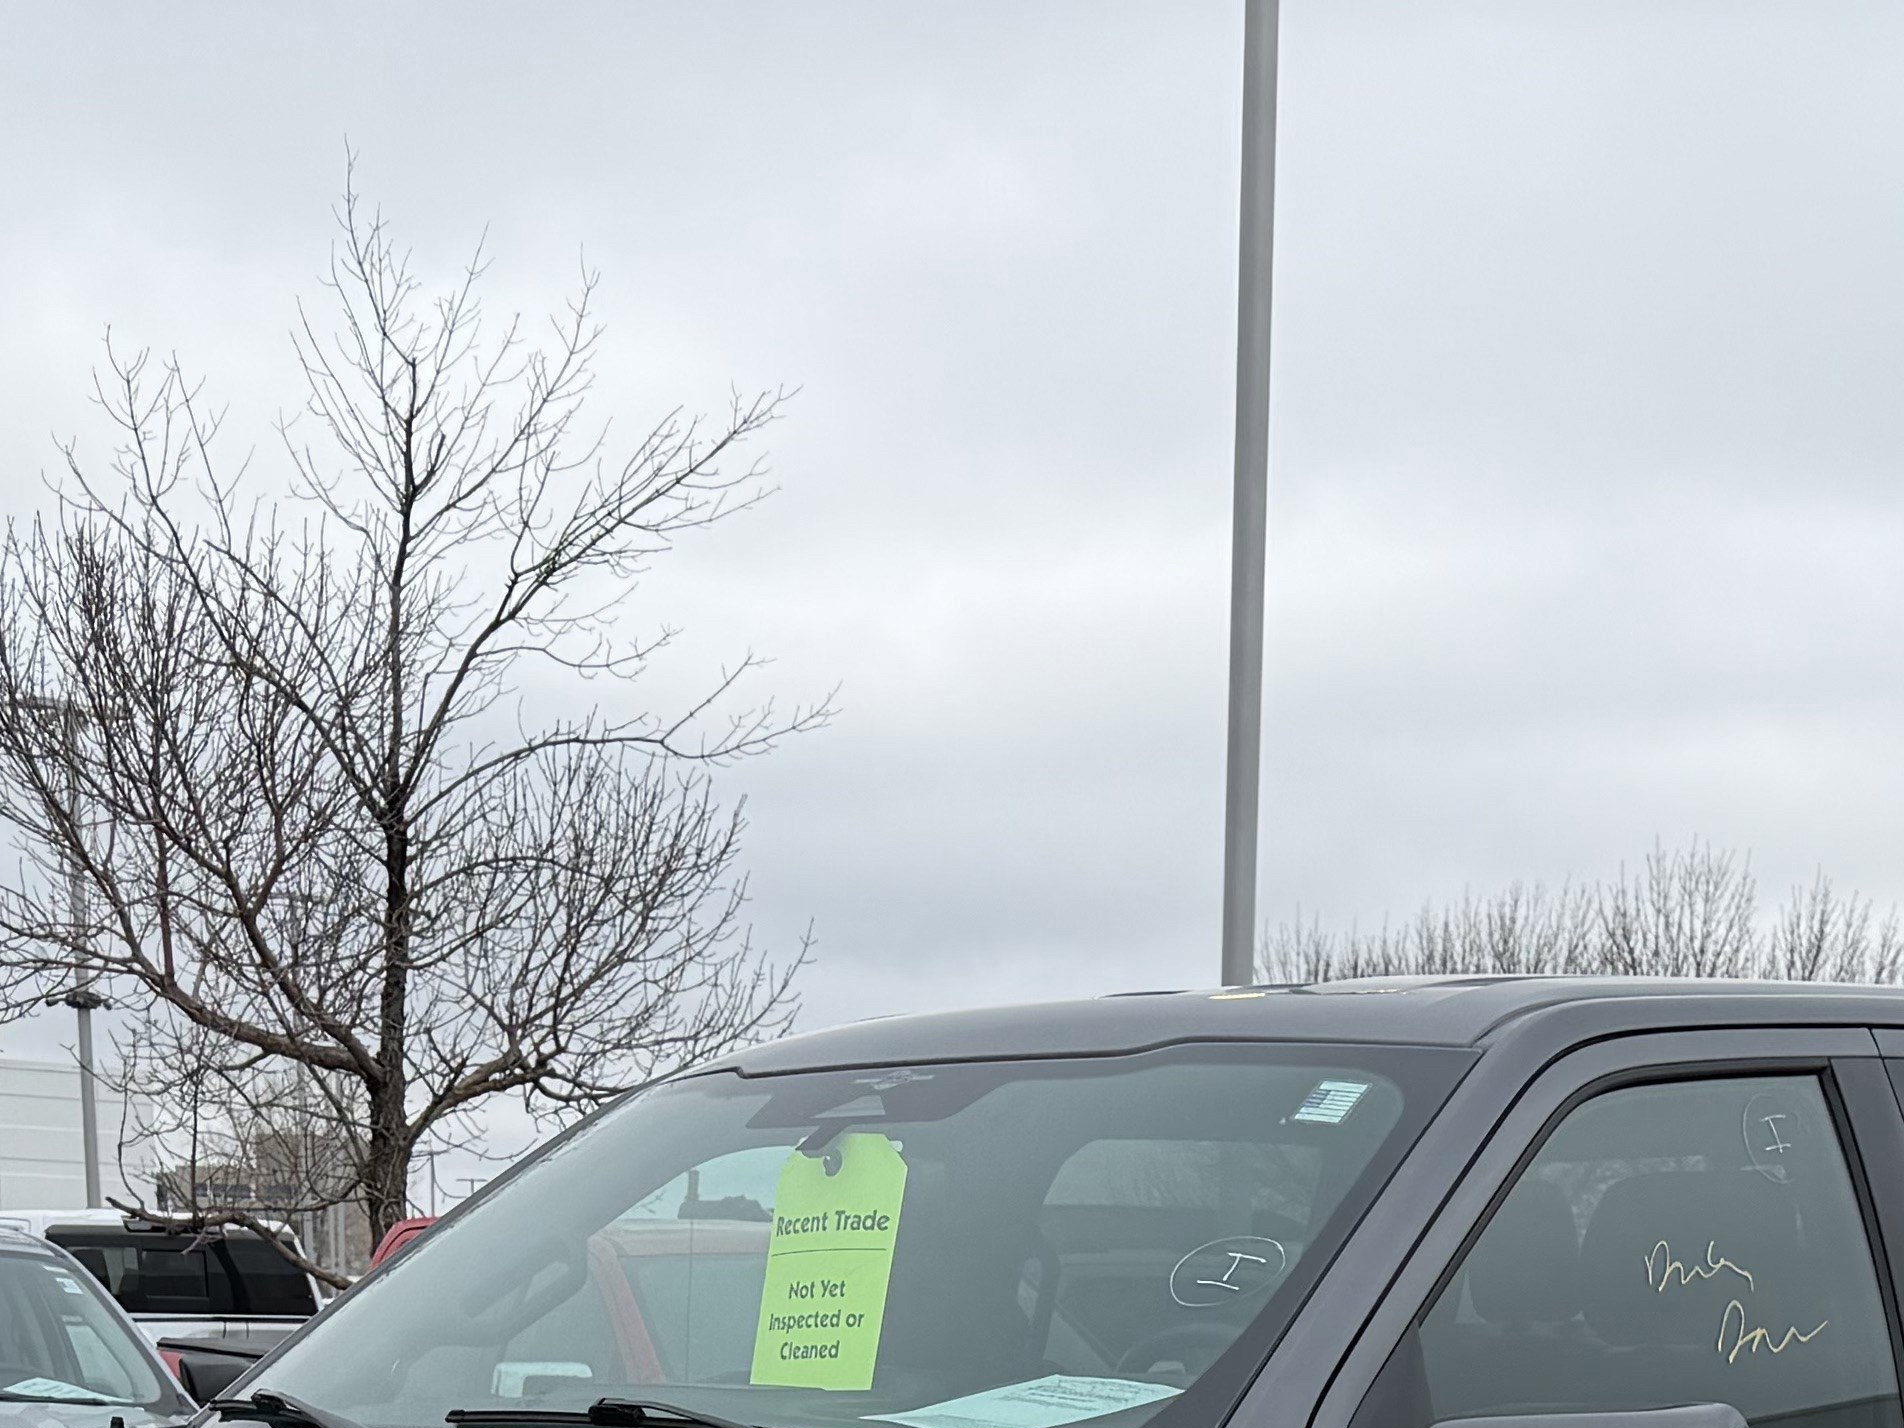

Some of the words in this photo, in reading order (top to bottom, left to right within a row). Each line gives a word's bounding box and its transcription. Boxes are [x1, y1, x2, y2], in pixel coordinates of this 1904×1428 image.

[776, 1211, 828, 1238] Recent
[835, 1209, 891, 1232] Trade
[788, 1281, 815, 1300] Not
[821, 1279, 846, 1299] Yet
[769, 1309, 842, 1334] Inspected
[845, 1312, 864, 1328] or
[779, 1339, 841, 1361] Cleaned
